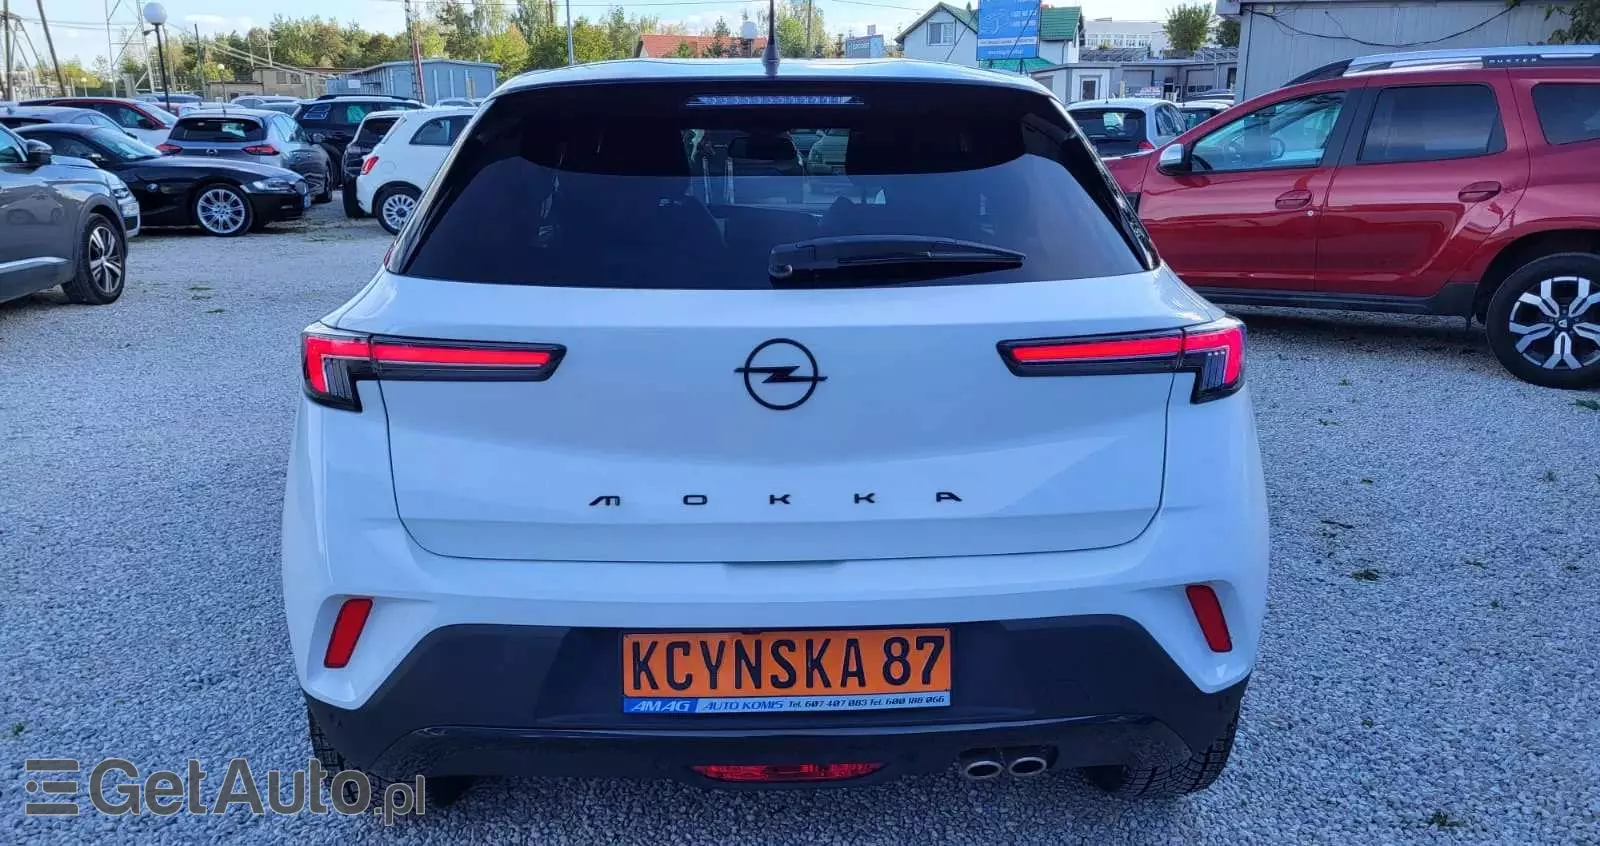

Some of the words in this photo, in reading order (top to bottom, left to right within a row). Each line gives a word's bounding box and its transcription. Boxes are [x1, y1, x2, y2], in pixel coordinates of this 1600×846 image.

[588, 491, 963, 507] MOKKA
[632, 637, 866, 691] KCYNSKA
[881, 635, 946, 687] 87
[703, 700, 739, 711] AUTO
[742, 699, 784, 710] KOMIS
[805, 700, 824, 708] 607
[827, 700, 846, 708] 407
[848, 699, 867, 707] 083
[885, 697, 906, 705] 600
[925, 695, 945, 704] 066
